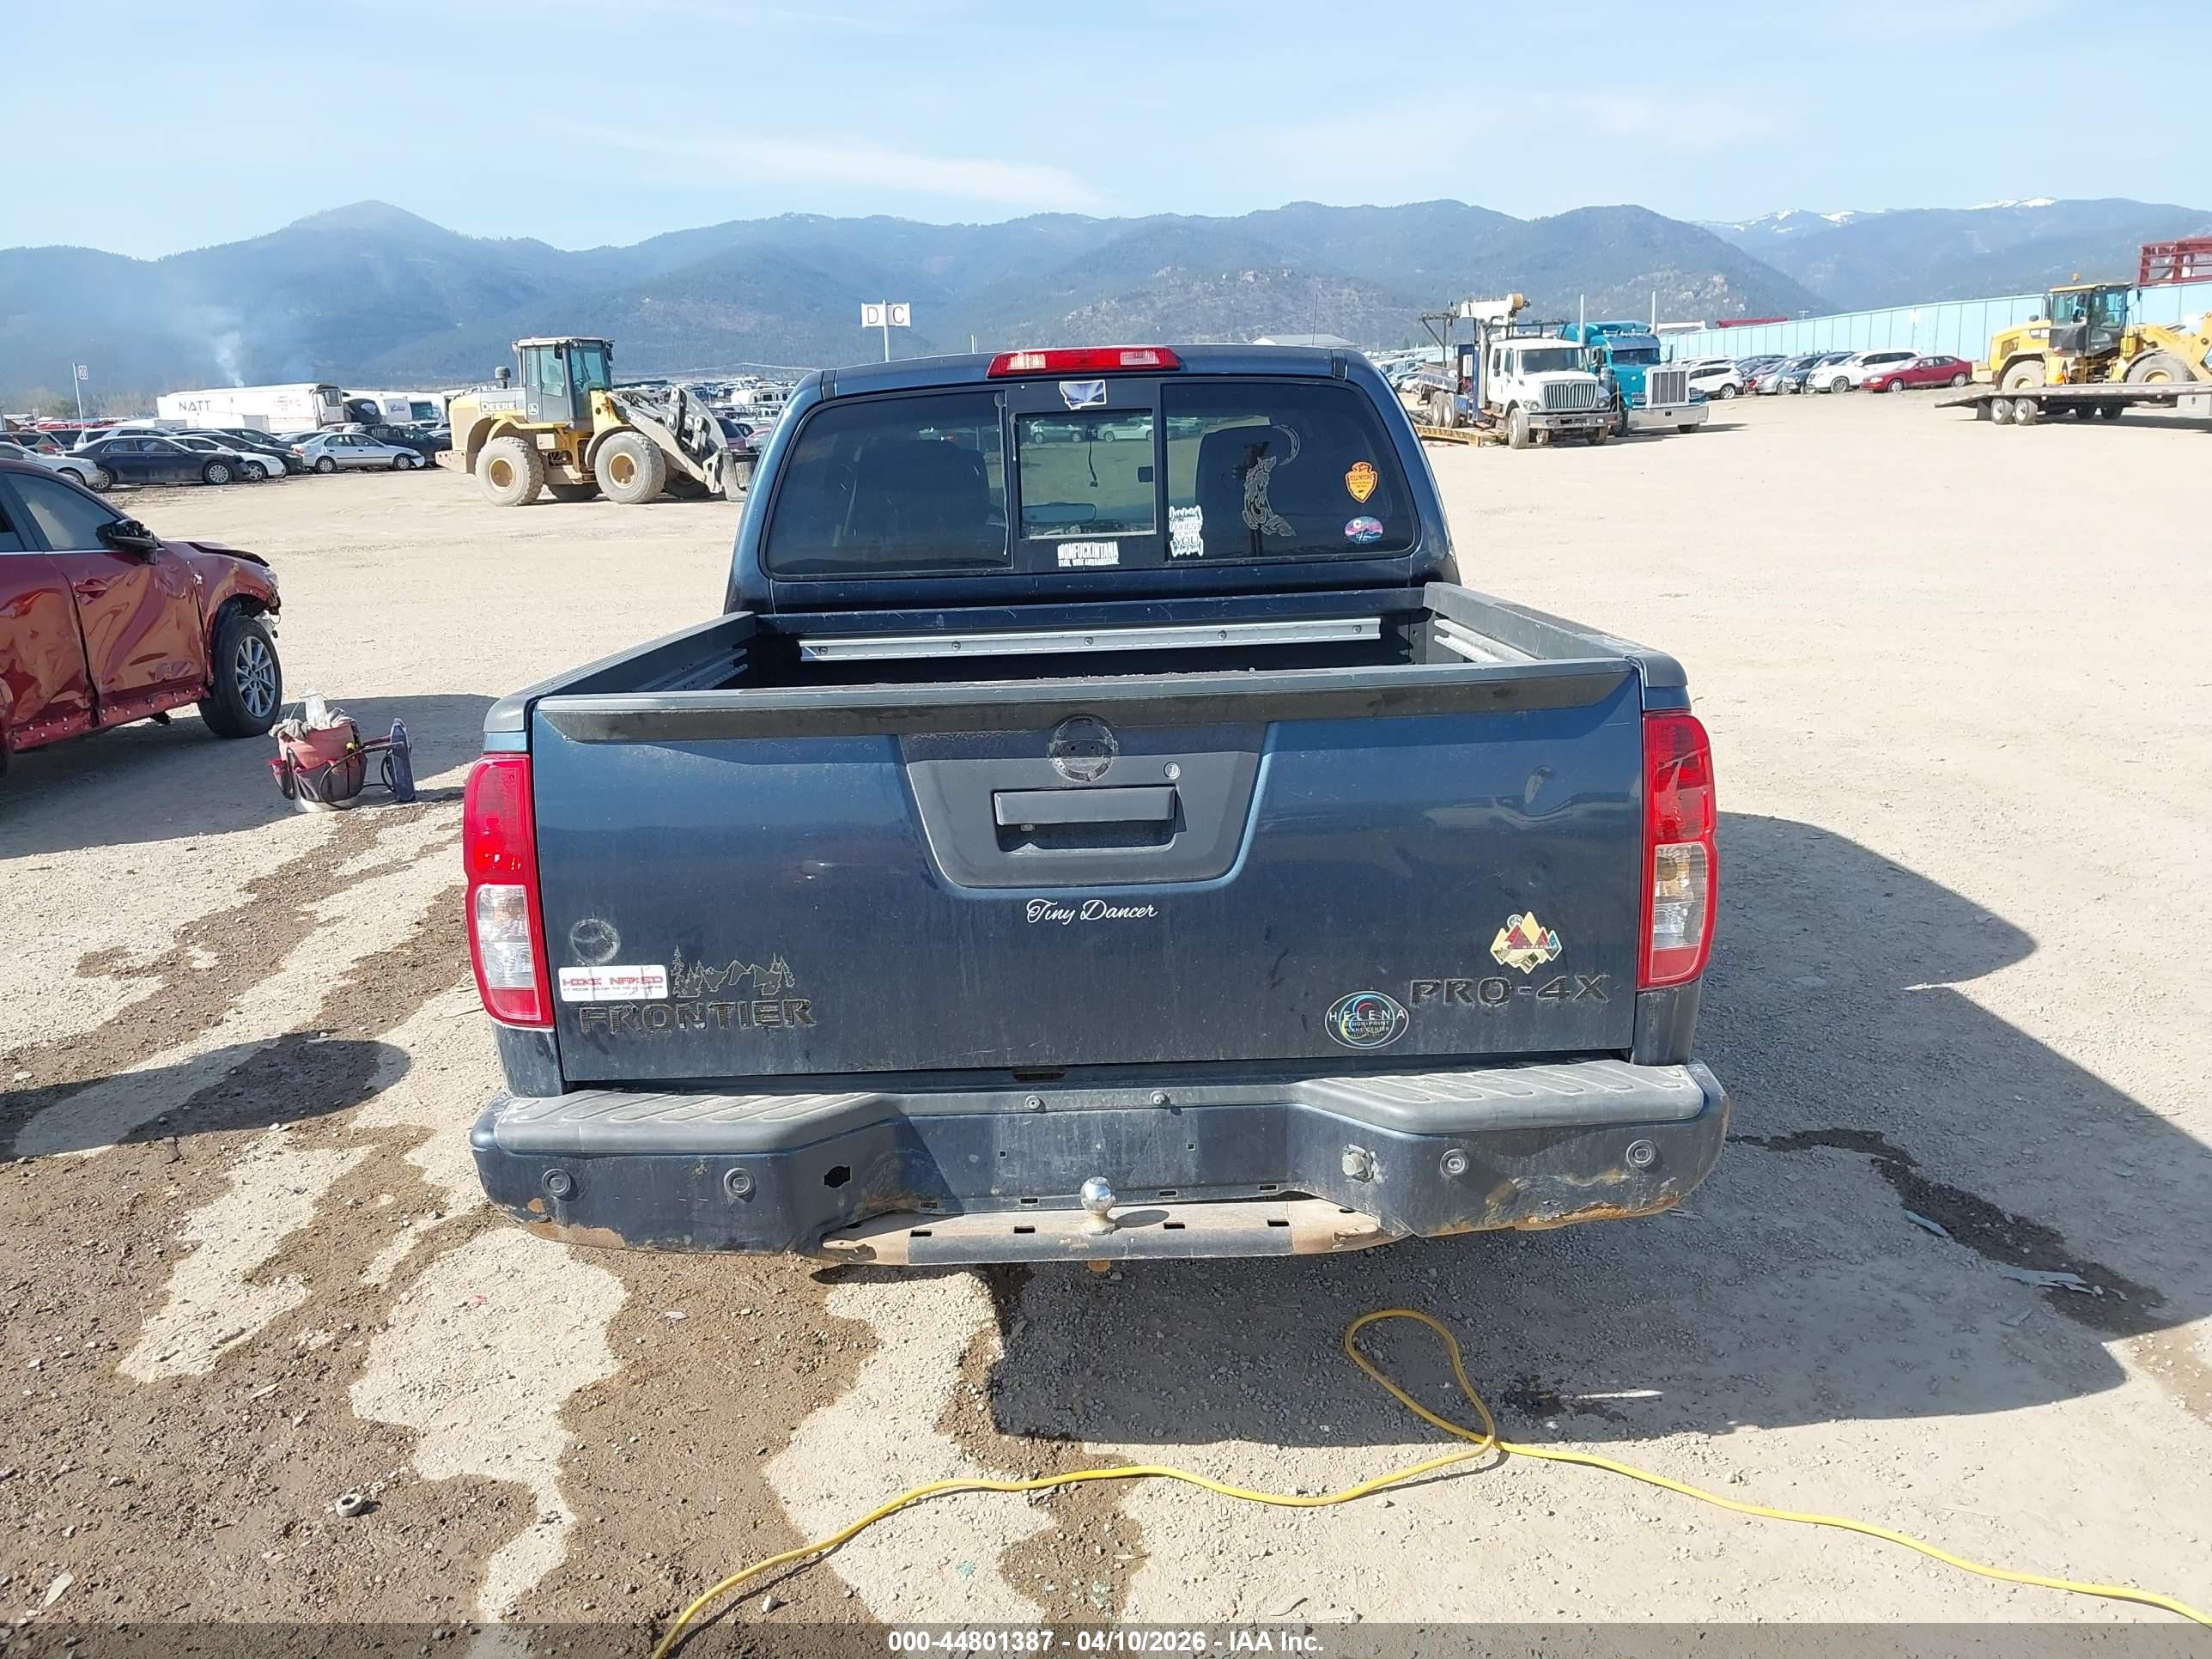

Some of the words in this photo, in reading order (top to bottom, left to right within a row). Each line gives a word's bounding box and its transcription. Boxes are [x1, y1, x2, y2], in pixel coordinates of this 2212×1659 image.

[866, 306, 879, 324] D
[893, 306, 905, 324] C
[179, 400, 211, 412] NATT
[481, 401, 516, 411] DEERE
[1174, 536, 1200, 546] YOU
[1058, 541, 1119, 559] MONFUCKINTANA
[1026, 898, 1076, 925] Tiny
[1079, 899, 1158, 921] Dancer
[562, 977, 603, 987] HIKE
[610, 975, 664, 985] NAKED
[1410, 974, 1611, 1007] PRO-4X
[579, 999, 816, 1034] FRONTIER
[1329, 1009, 1406, 1022] HELENA
